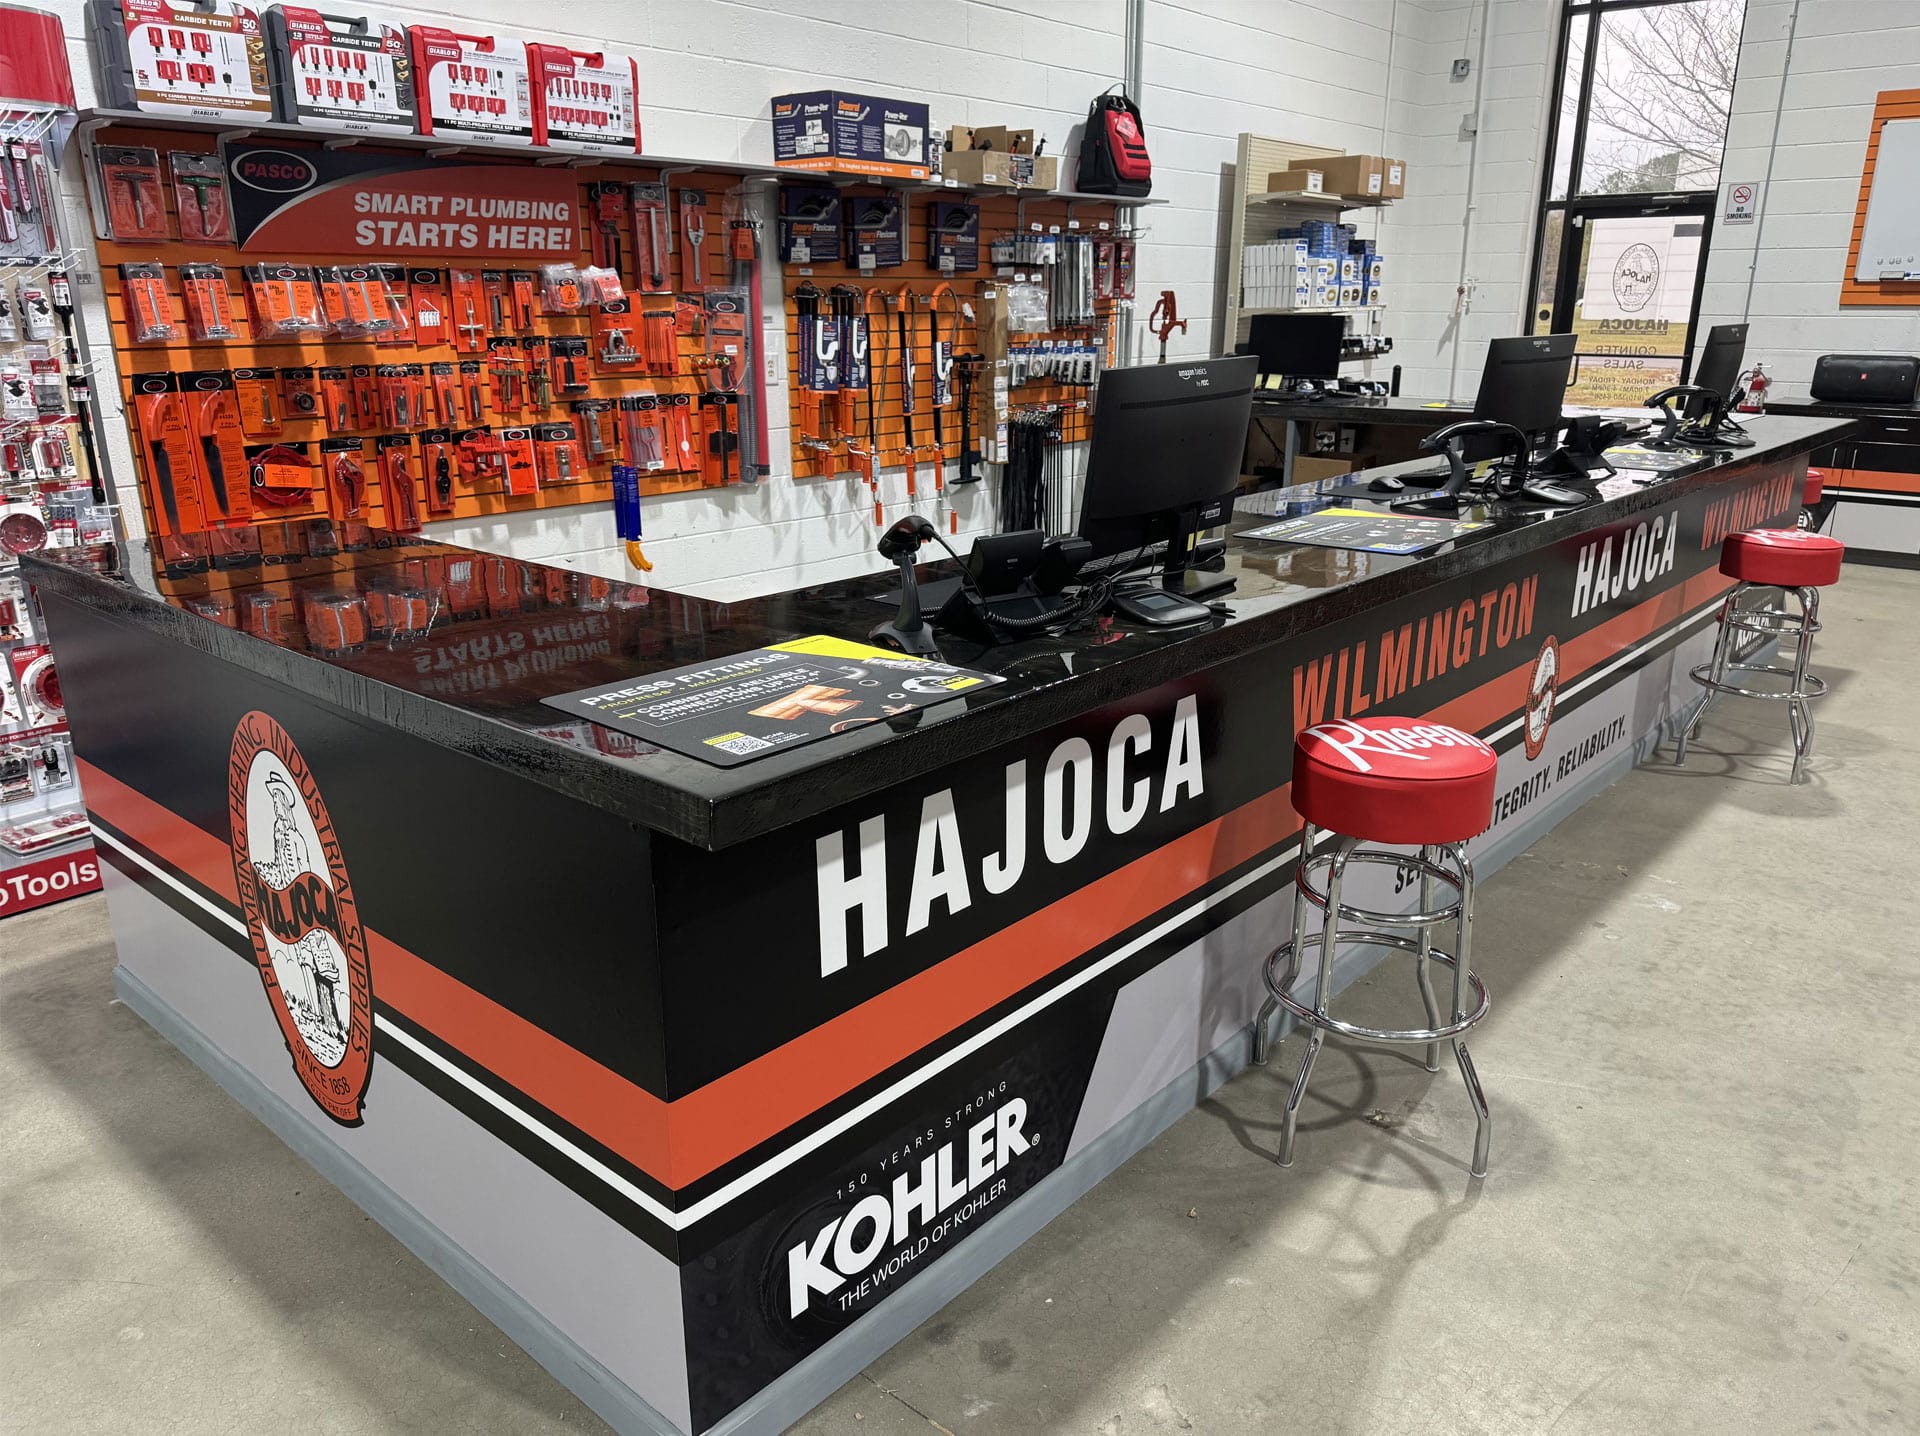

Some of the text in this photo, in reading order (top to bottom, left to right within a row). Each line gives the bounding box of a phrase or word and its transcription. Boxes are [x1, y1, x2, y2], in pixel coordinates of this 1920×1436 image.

[174, 14, 206, 25] CARBIDE
[208, 19, 232, 28] TEETH
[291, 22, 314, 31] DIABLO
[332, 36, 360, 46] CARBIDE
[361, 40, 381, 48] TEETH
[429, 47, 451, 56] DIABLO
[244, 161, 307, 180] PASCO
[354, 192, 569, 221] SMART PLUMBING
[1726, 211, 1752, 220] SMOKING
[355, 220, 572, 250] STARTS HERE!
[1701, 472, 1796, 551] WILMINGTON
[1571, 510, 1679, 619] HAJOCA
[580, 653, 790, 706] PRESS FITTINGS
[1293, 573, 1539, 742] WILMINGTON
[636, 668, 809, 714] CONSISTENT, RELIABLE
[648, 683, 763, 718] CONNECTIONS
[762, 678, 784, 692] UP
[786, 673, 807, 685] TO
[1301, 718, 1491, 772] Rheem
[1556, 714, 1626, 782] RELIABILITY.
[1478, 765, 1551, 836] TEGRITY.
[816, 694, 1204, 978] HAJOCA
[258, 875, 344, 947] HAJOCA
[269, 719, 353, 913] INDUSTRIAL
[343, 920, 367, 1063] SUPPLIES
[295, 1040, 351, 1096] SINCE 1858
[836, 1081, 1008, 1200] 150 YEARS STRONG
[838, 1179, 1008, 1312] THE WORLD OF KOHLER
